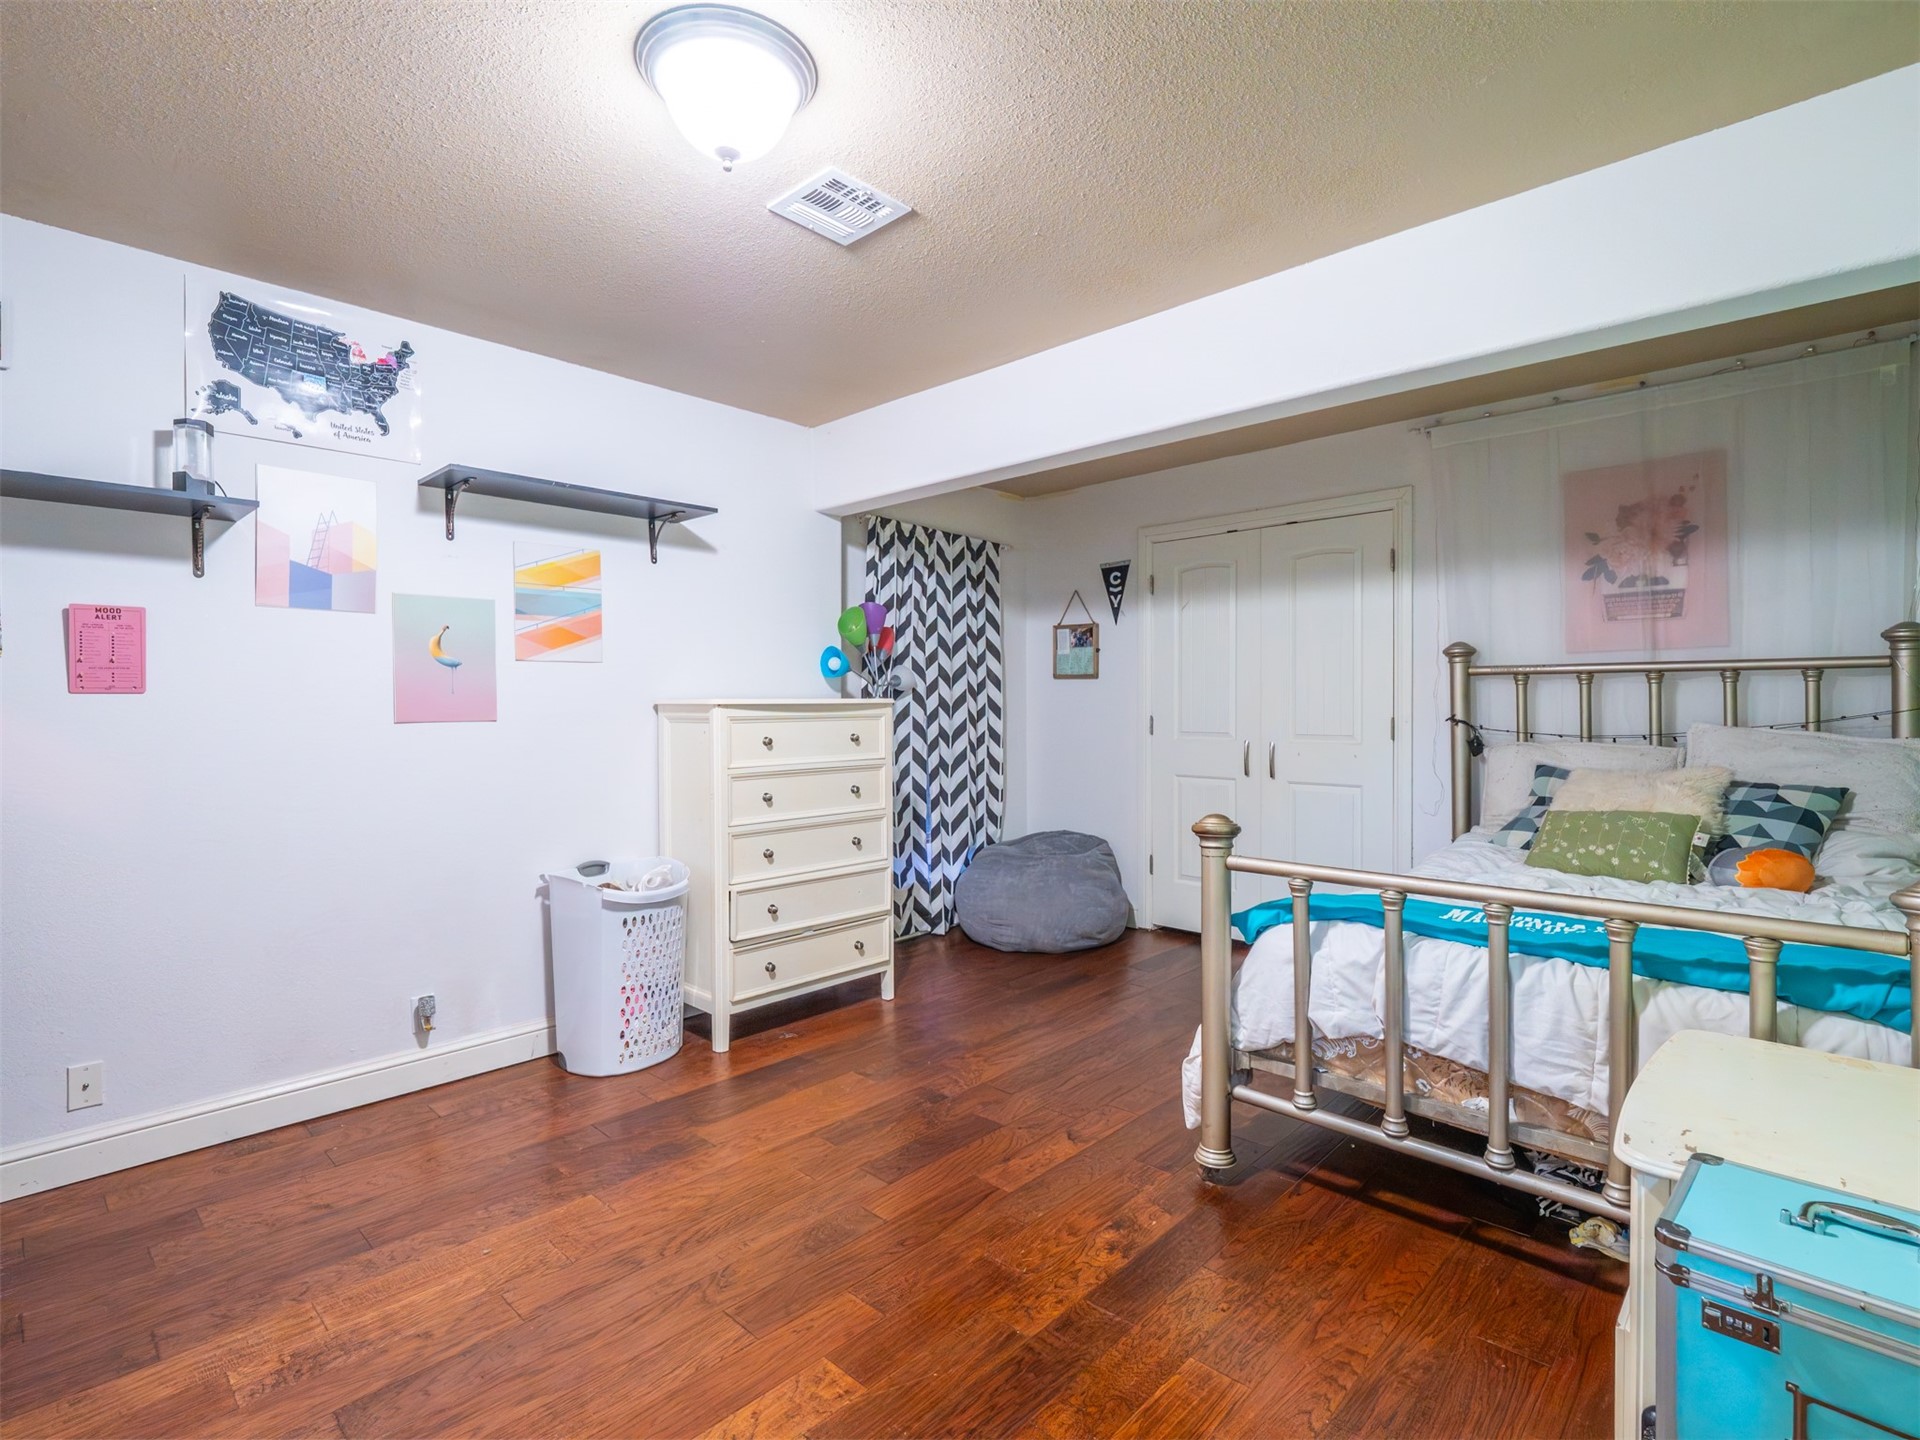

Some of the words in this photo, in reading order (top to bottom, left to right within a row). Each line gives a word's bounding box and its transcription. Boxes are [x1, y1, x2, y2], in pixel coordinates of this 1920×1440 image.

[330, 421, 353, 433] United
[354, 426, 375, 437] States
[333, 430, 342, 440] of
[342, 431, 372, 443] America
